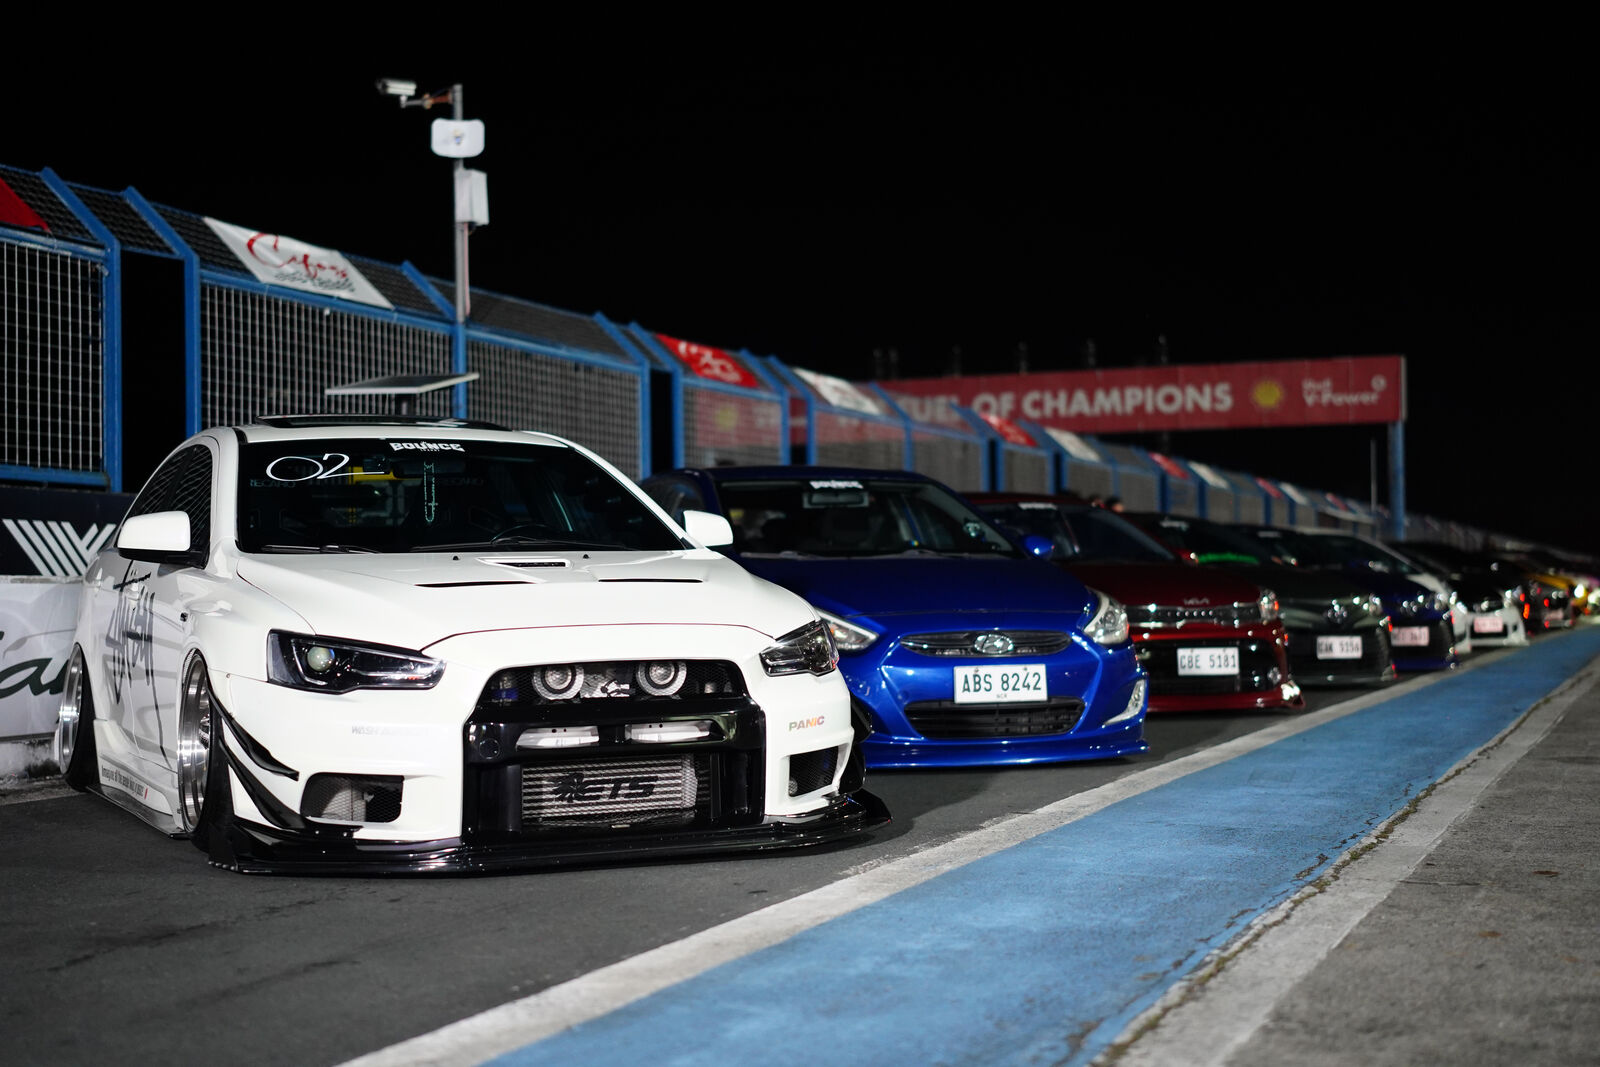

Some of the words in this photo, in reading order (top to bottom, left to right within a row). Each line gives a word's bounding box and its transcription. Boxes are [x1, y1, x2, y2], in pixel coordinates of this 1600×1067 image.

[972, 391, 1015, 420] OF
[1022, 383, 1233, 418] CHAMPIONS
[389, 441, 466, 451] BOUNCE
[1180, 655, 1201, 669] CBE
[1209, 655, 1237, 668] 5181
[962, 674, 993, 693] ABS
[1001, 672, 1042, 691] 8242
[788, 715, 825, 731] PANIC
[582, 776, 659, 801] ETS
